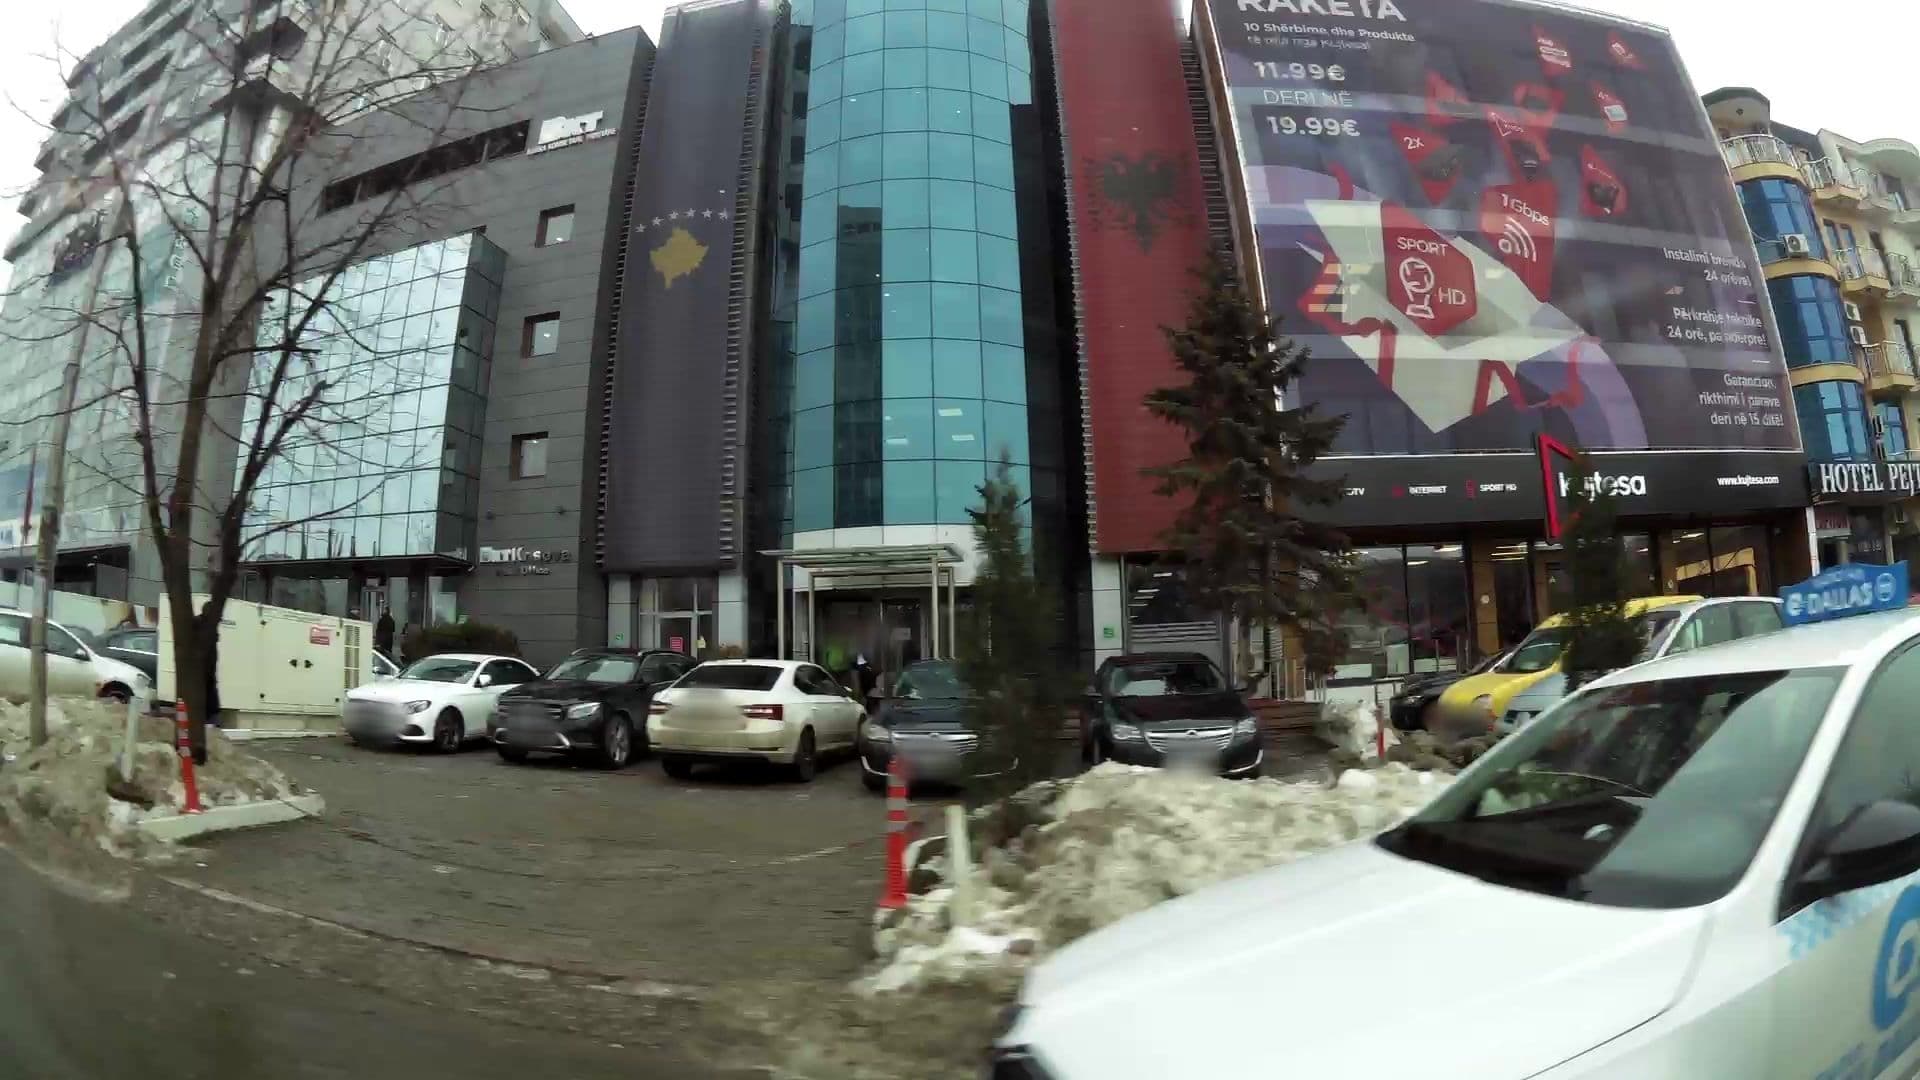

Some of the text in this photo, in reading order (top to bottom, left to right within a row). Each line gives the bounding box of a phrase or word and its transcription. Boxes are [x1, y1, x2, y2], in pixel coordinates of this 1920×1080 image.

[1243, 22, 1260, 32] 10
[1358, 28, 1416, 42] Produkte
[1254, 61, 1345, 81] 11.99€
[1263, 89, 1352, 107] DERI NË
[1266, 116, 1361, 137] 19.99€
[1397, 236, 1448, 256] SPORT
[1704, 269, 1718, 281] 24
[1438, 287, 1466, 305] HD
[1667, 325, 1682, 339] 24
[1559, 471, 1647, 502] kjtesa
[1716, 474, 1780, 487] www.kujtesa.com
[1819, 463, 1885, 493] HOTEL
[1479, 484, 1504, 493] SPORT
